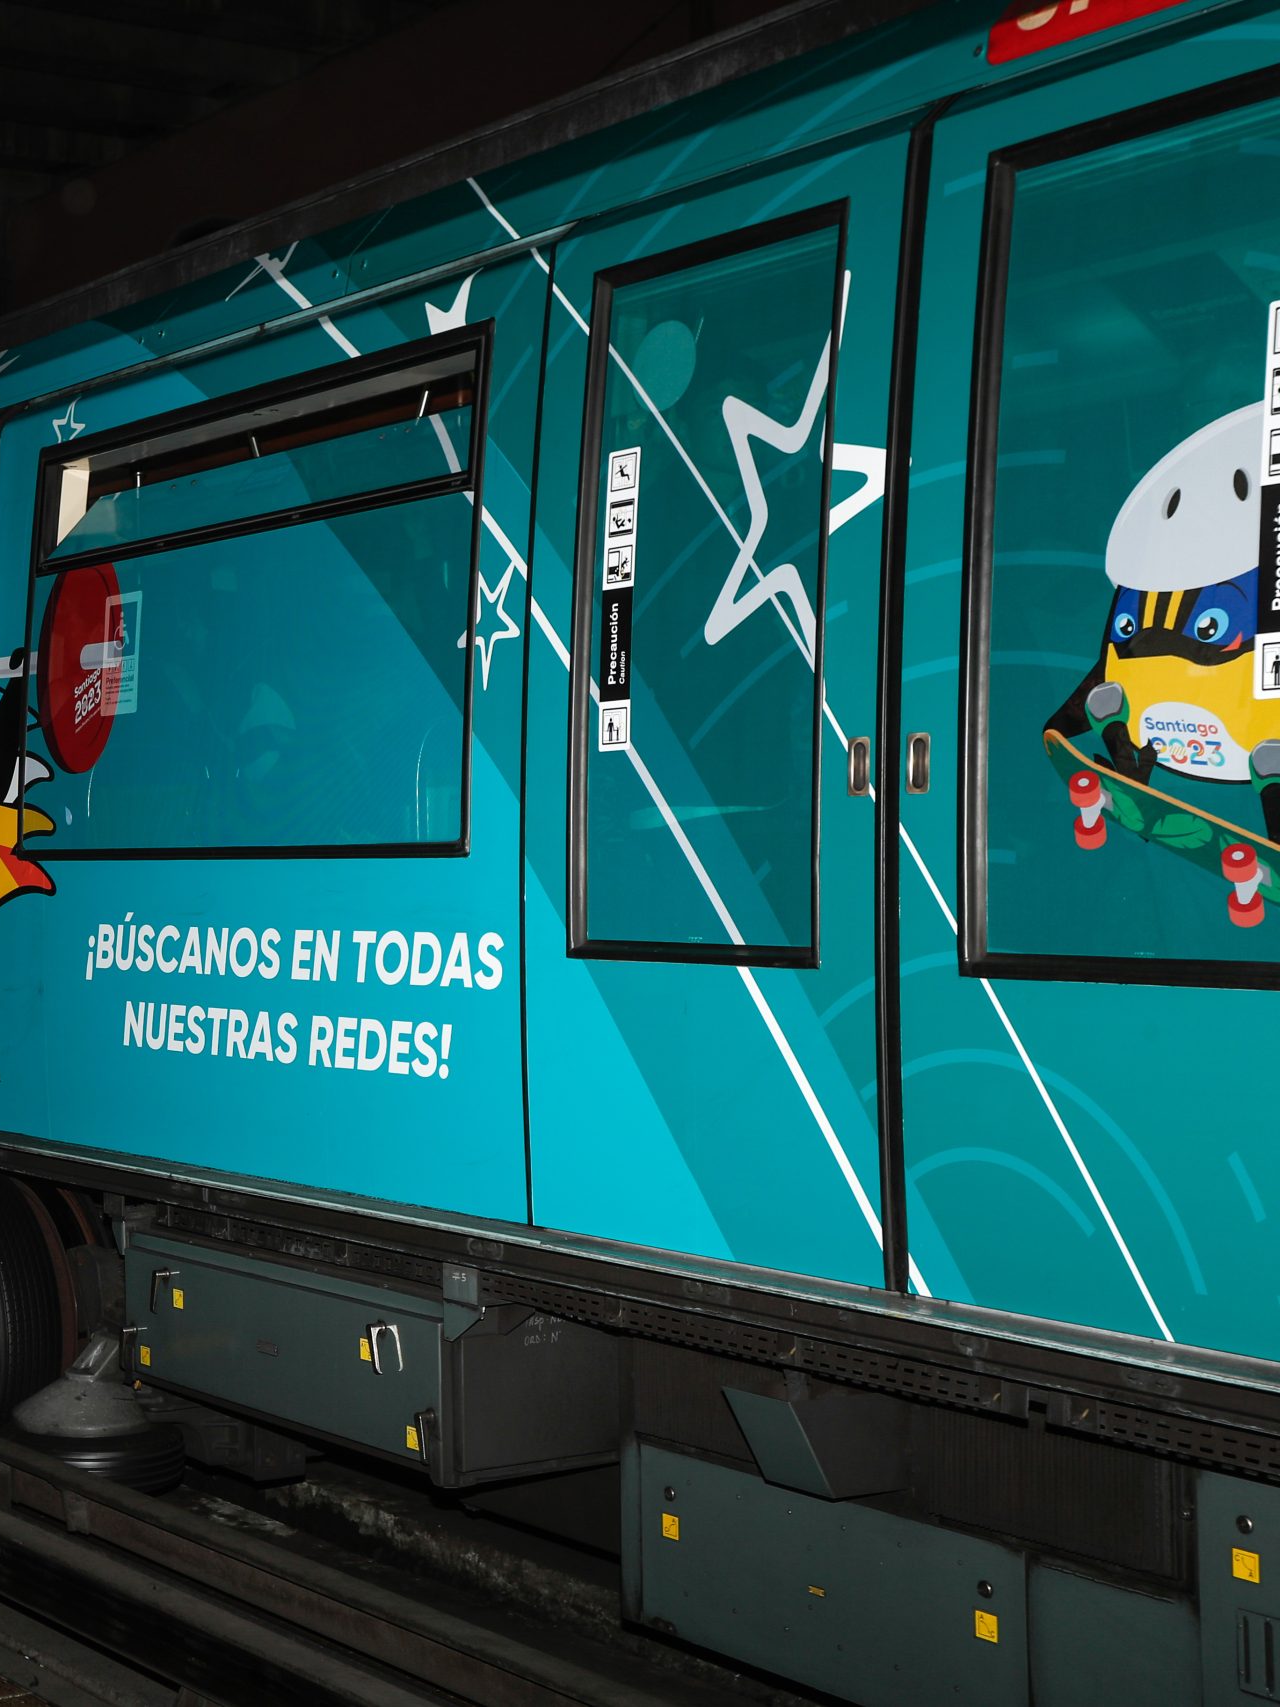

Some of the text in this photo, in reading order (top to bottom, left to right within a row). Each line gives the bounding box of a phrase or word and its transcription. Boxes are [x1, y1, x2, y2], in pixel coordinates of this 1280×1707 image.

[607, 602, 620, 686] Precaución
[74, 668, 101, 698] Santiago
[618, 650, 626, 685] Caution
[74, 679, 101, 725] 2023
[1144, 716, 1218, 737] Santiago
[1148, 736, 1226, 767] 2023
[84, 911, 505, 991] ¡BÚSCANOS EN TODAS
[123, 1000, 453, 1080] NUESTRAS REDES!
